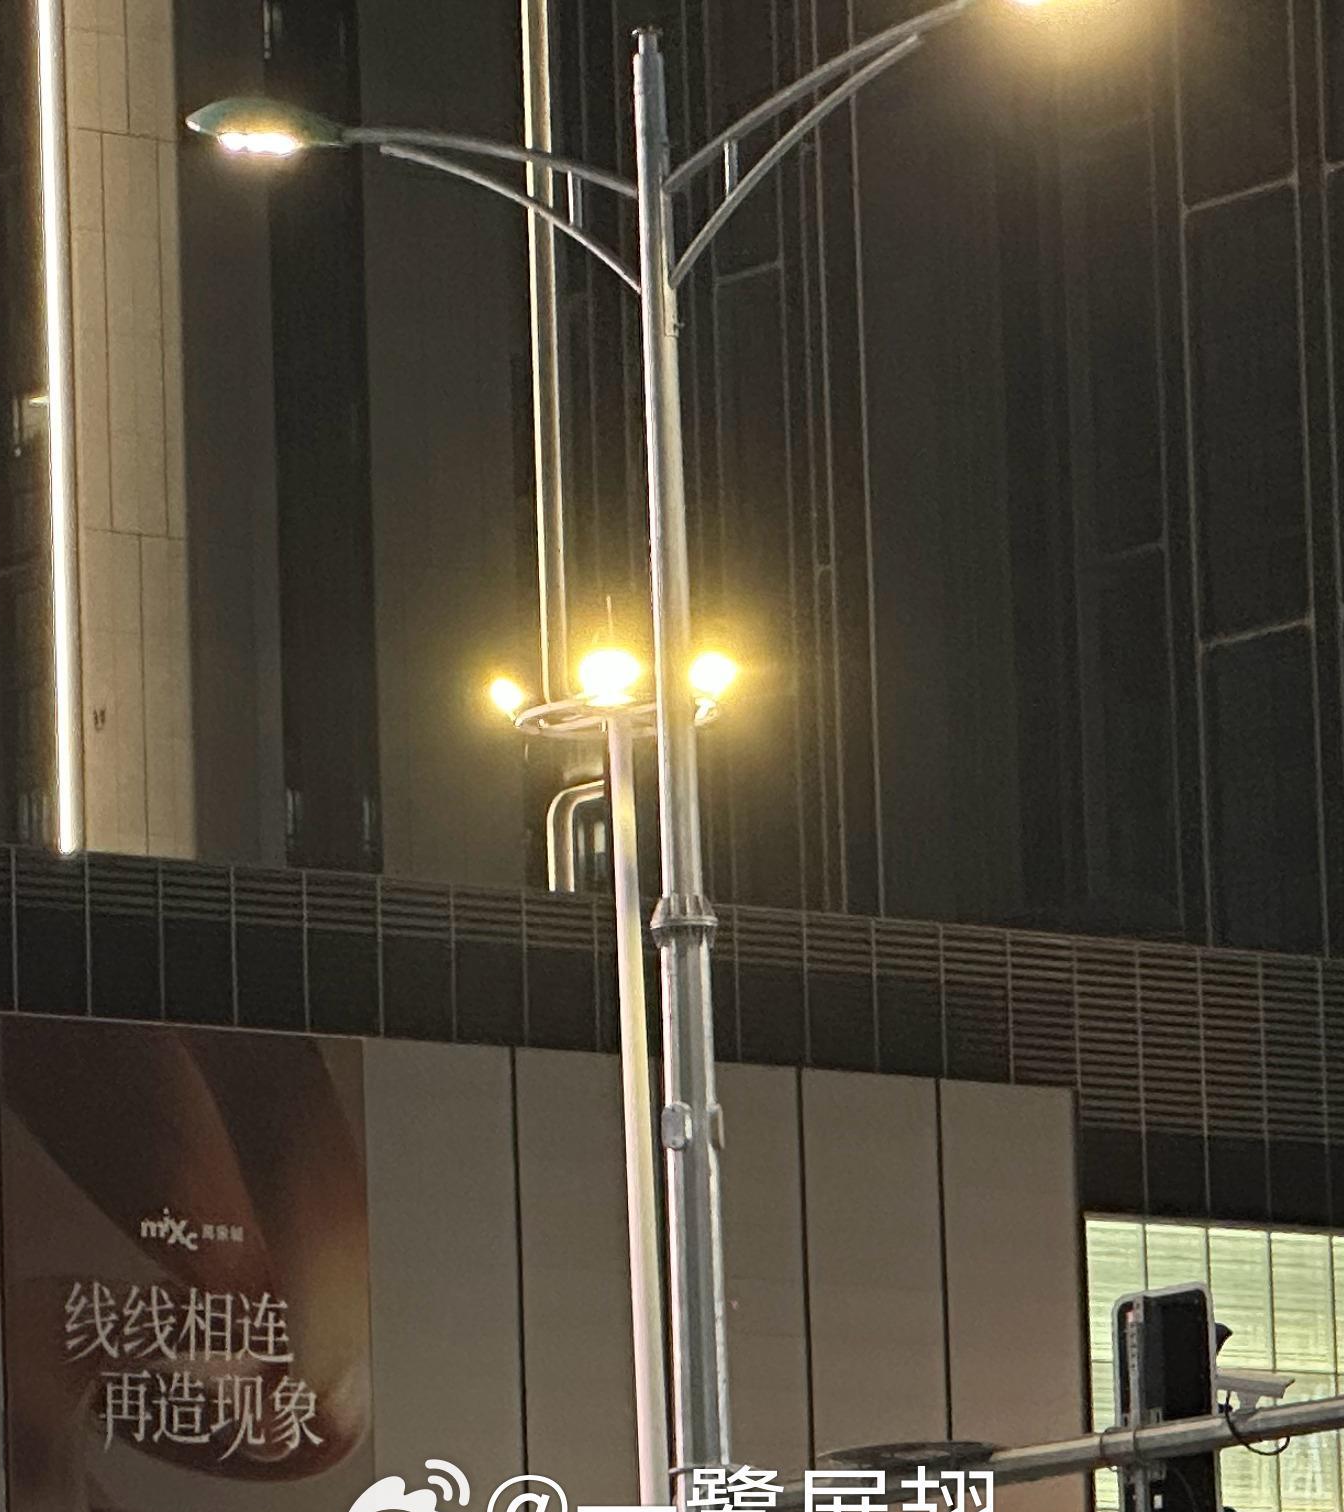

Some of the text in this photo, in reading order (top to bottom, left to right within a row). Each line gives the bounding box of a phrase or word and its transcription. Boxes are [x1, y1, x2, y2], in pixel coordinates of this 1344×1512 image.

[64, 1282, 294, 1363] 线线相连
[100, 1370, 324, 1462] 再造现象
